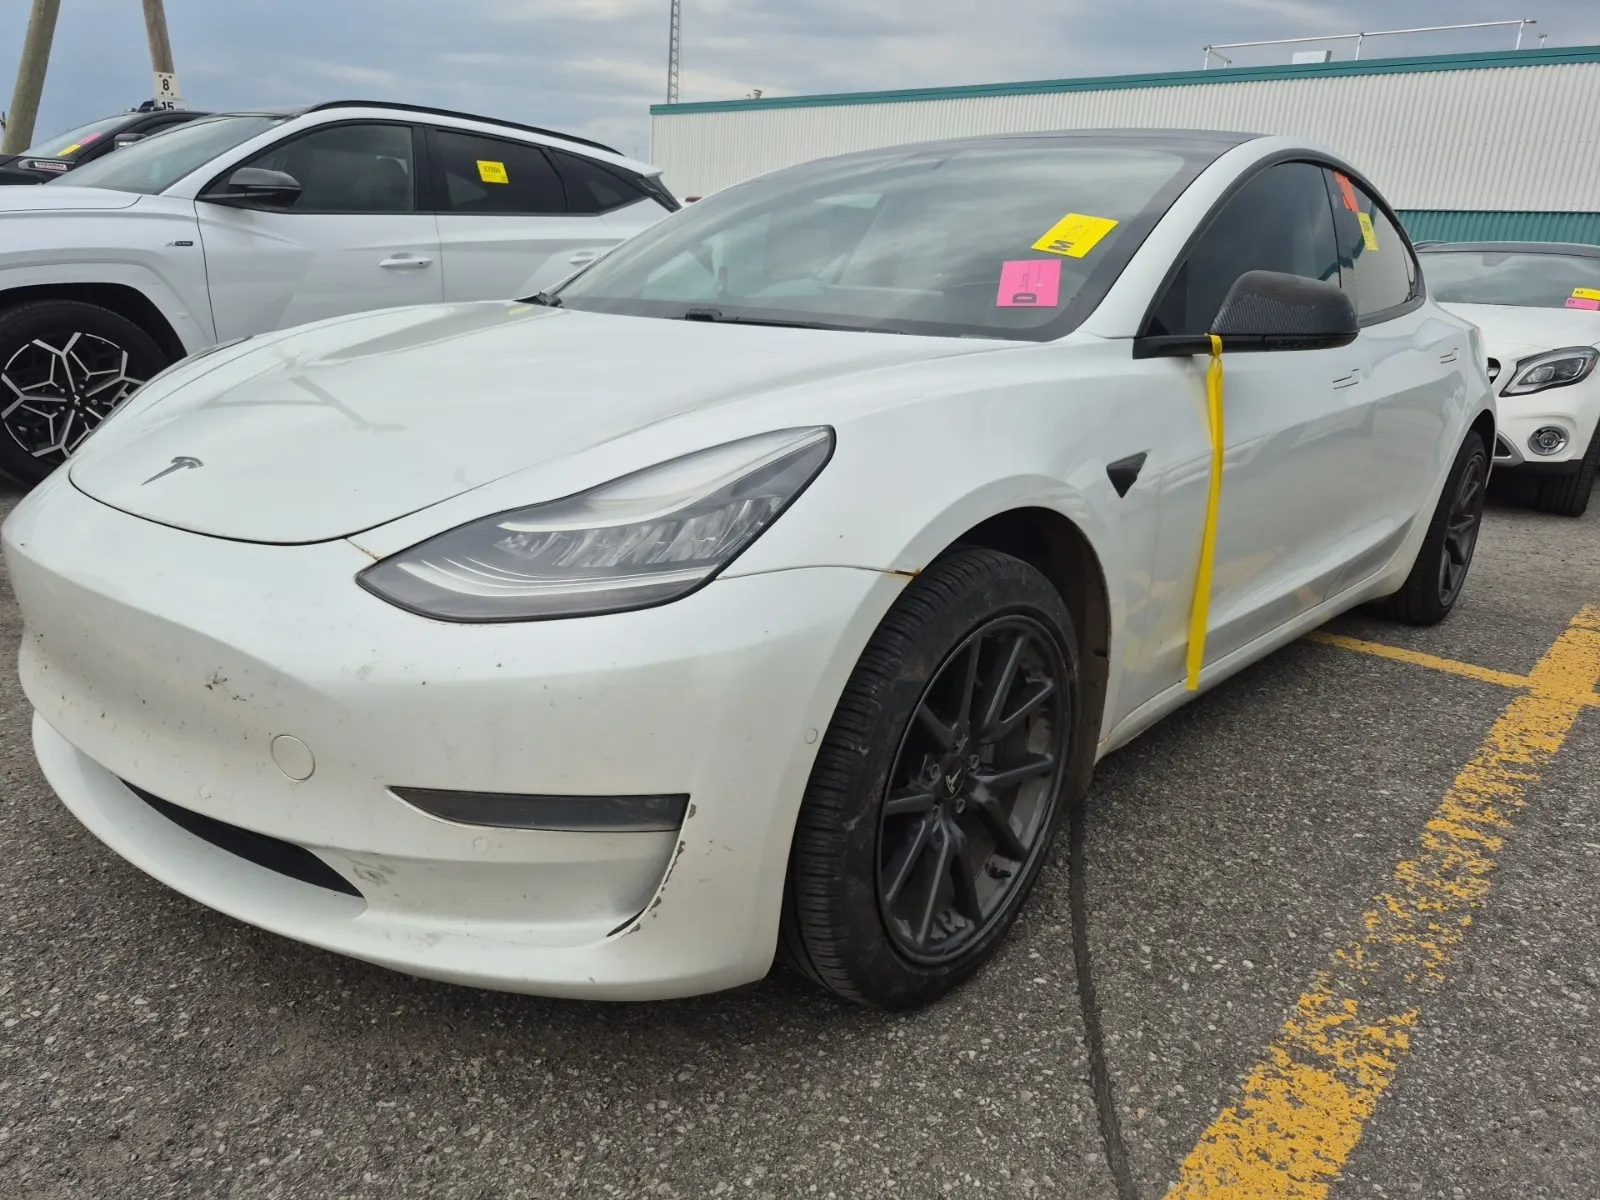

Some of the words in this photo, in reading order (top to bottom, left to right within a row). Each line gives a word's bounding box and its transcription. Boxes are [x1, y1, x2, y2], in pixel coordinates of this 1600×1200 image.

[162, 79, 170, 91] 8
[161, 101, 175, 111] 15
[1047, 239, 1075, 252] M
[1012, 292, 1038, 304] D
